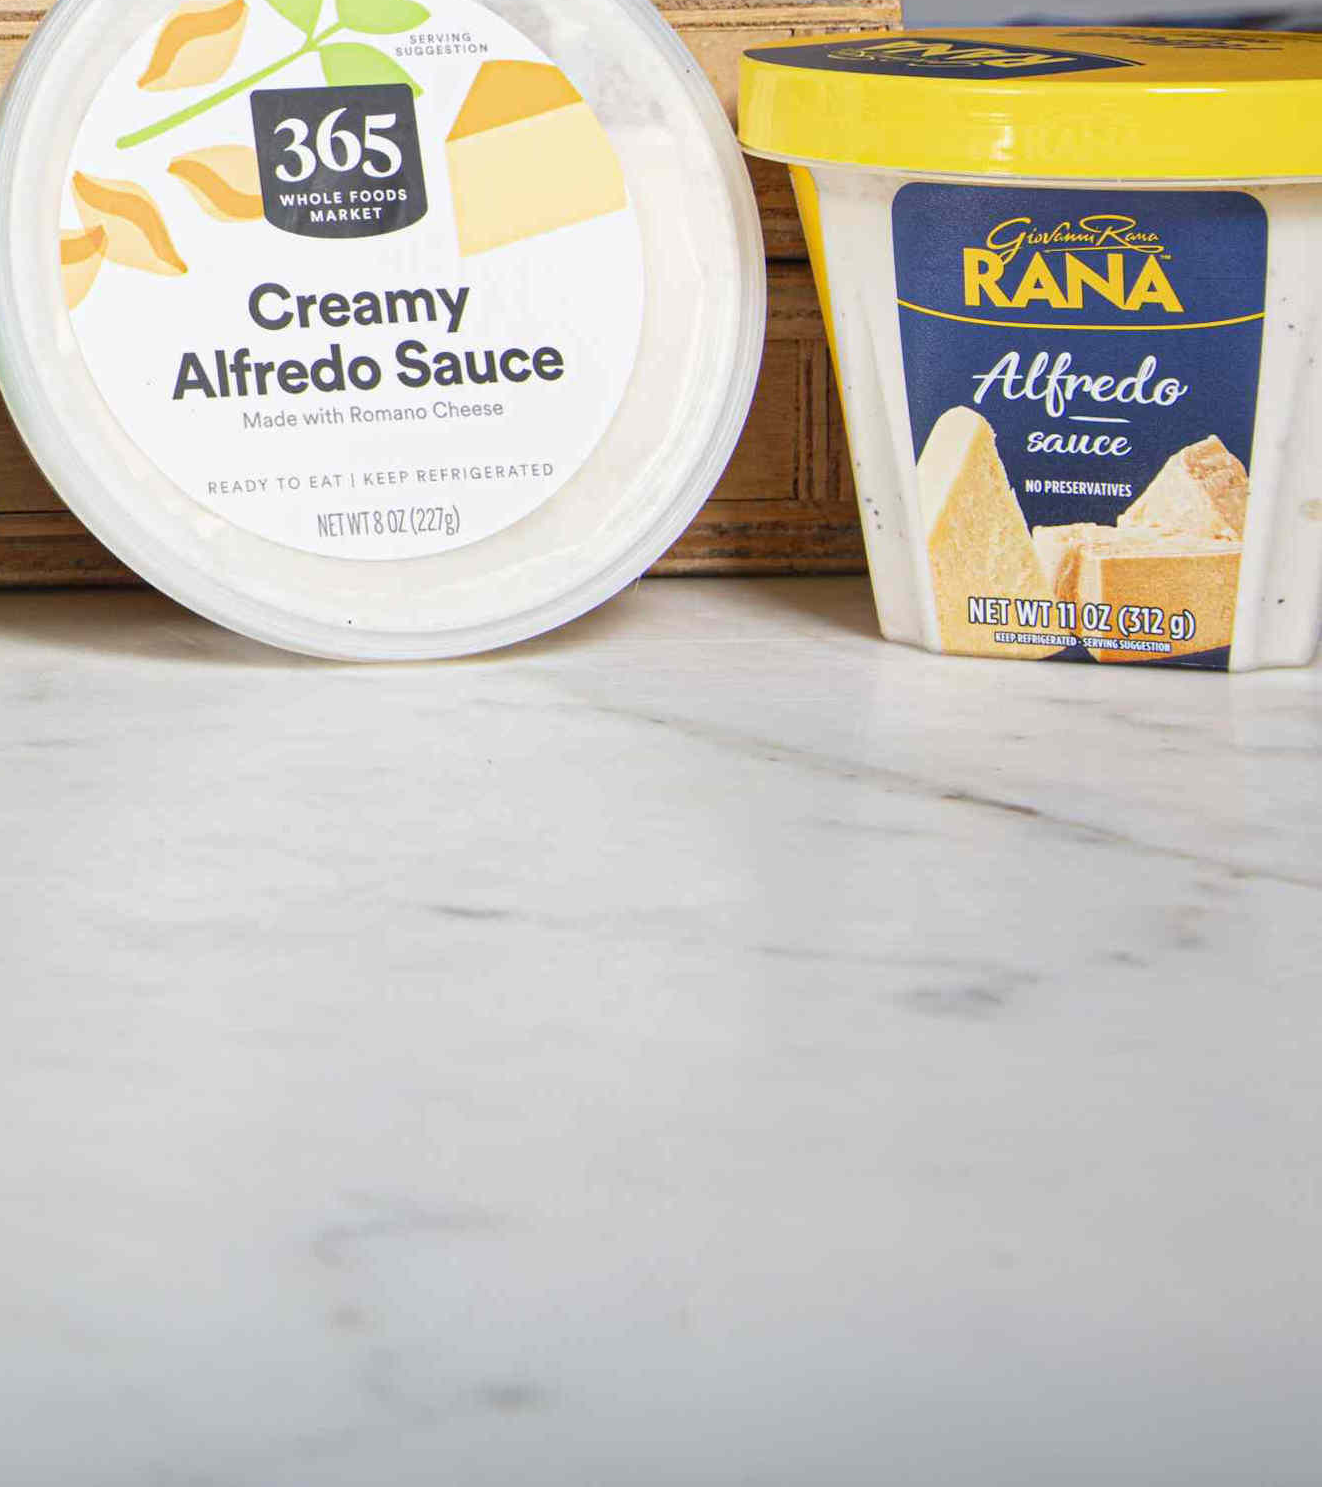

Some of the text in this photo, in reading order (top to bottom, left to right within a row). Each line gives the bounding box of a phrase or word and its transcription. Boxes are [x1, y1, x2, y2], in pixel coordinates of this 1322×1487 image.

[396, 44, 488, 56] SUGGESTION
[410, 32, 471, 44] SERVING
[274, 106, 402, 183] 365
[280, 187, 407, 207] WHOLE FOODS
[310, 207, 382, 223] MARKET
[963, 247, 1185, 312] RANA
[248, 283, 469, 332] Creamy
[172, 339, 564, 401] Alfredo Sauce
[972, 351, 1187, 417] Alfredo
[243, 398, 504, 430] Made with Romano Cheese
[1027, 431, 1131, 458] sauce
[207, 462, 553, 496] READY TO EAT KEEP REFRIGERATED
[1025, 478, 1132, 498] NO PRESERVATIVES
